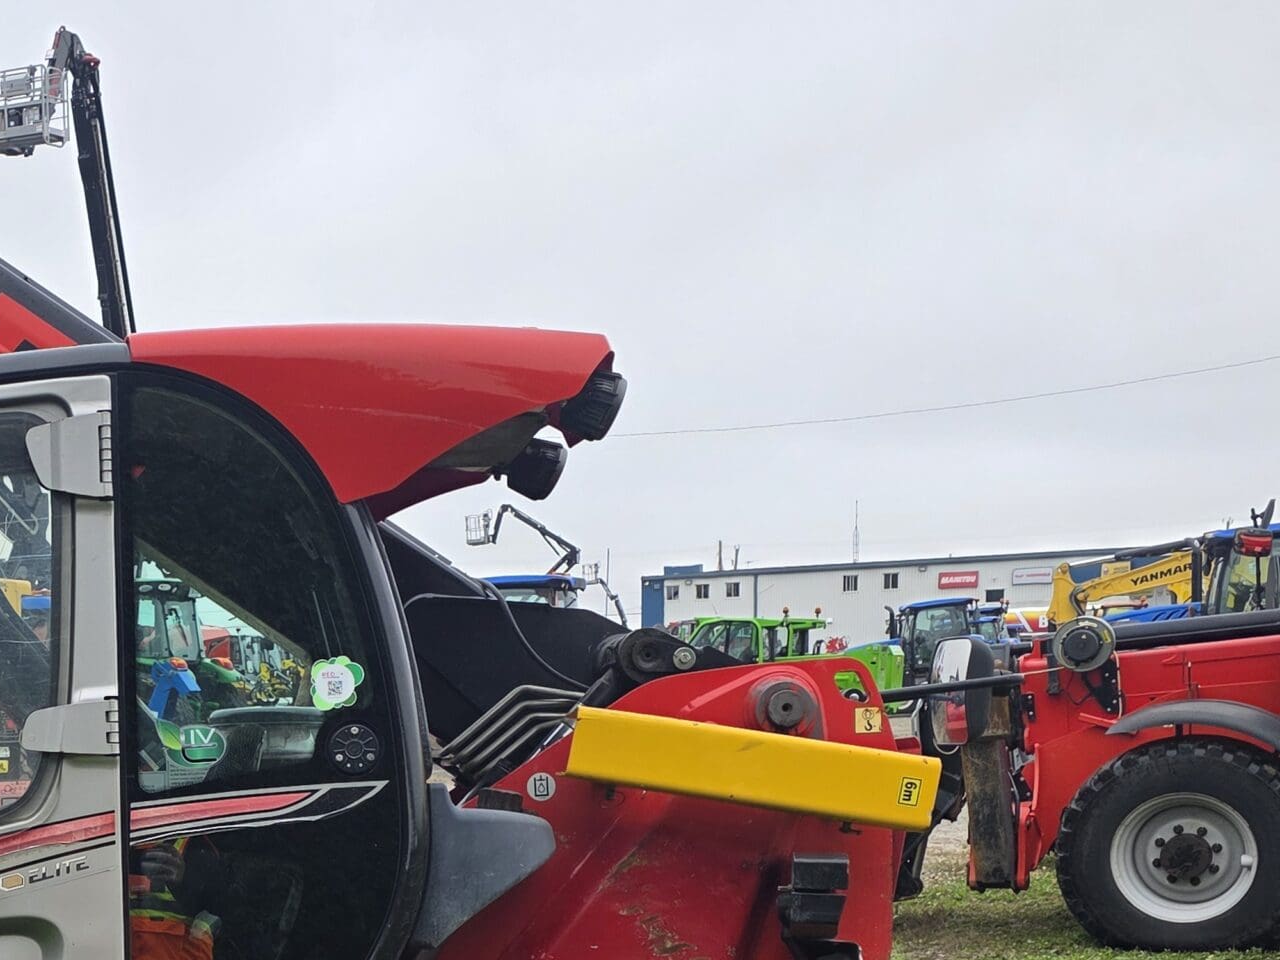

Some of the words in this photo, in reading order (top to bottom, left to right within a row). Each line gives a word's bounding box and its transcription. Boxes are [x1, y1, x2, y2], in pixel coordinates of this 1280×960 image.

[1131, 562, 1193, 586] YANMAR
[901, 781, 917, 802] 6m
[28, 855, 90, 884] ELITE
